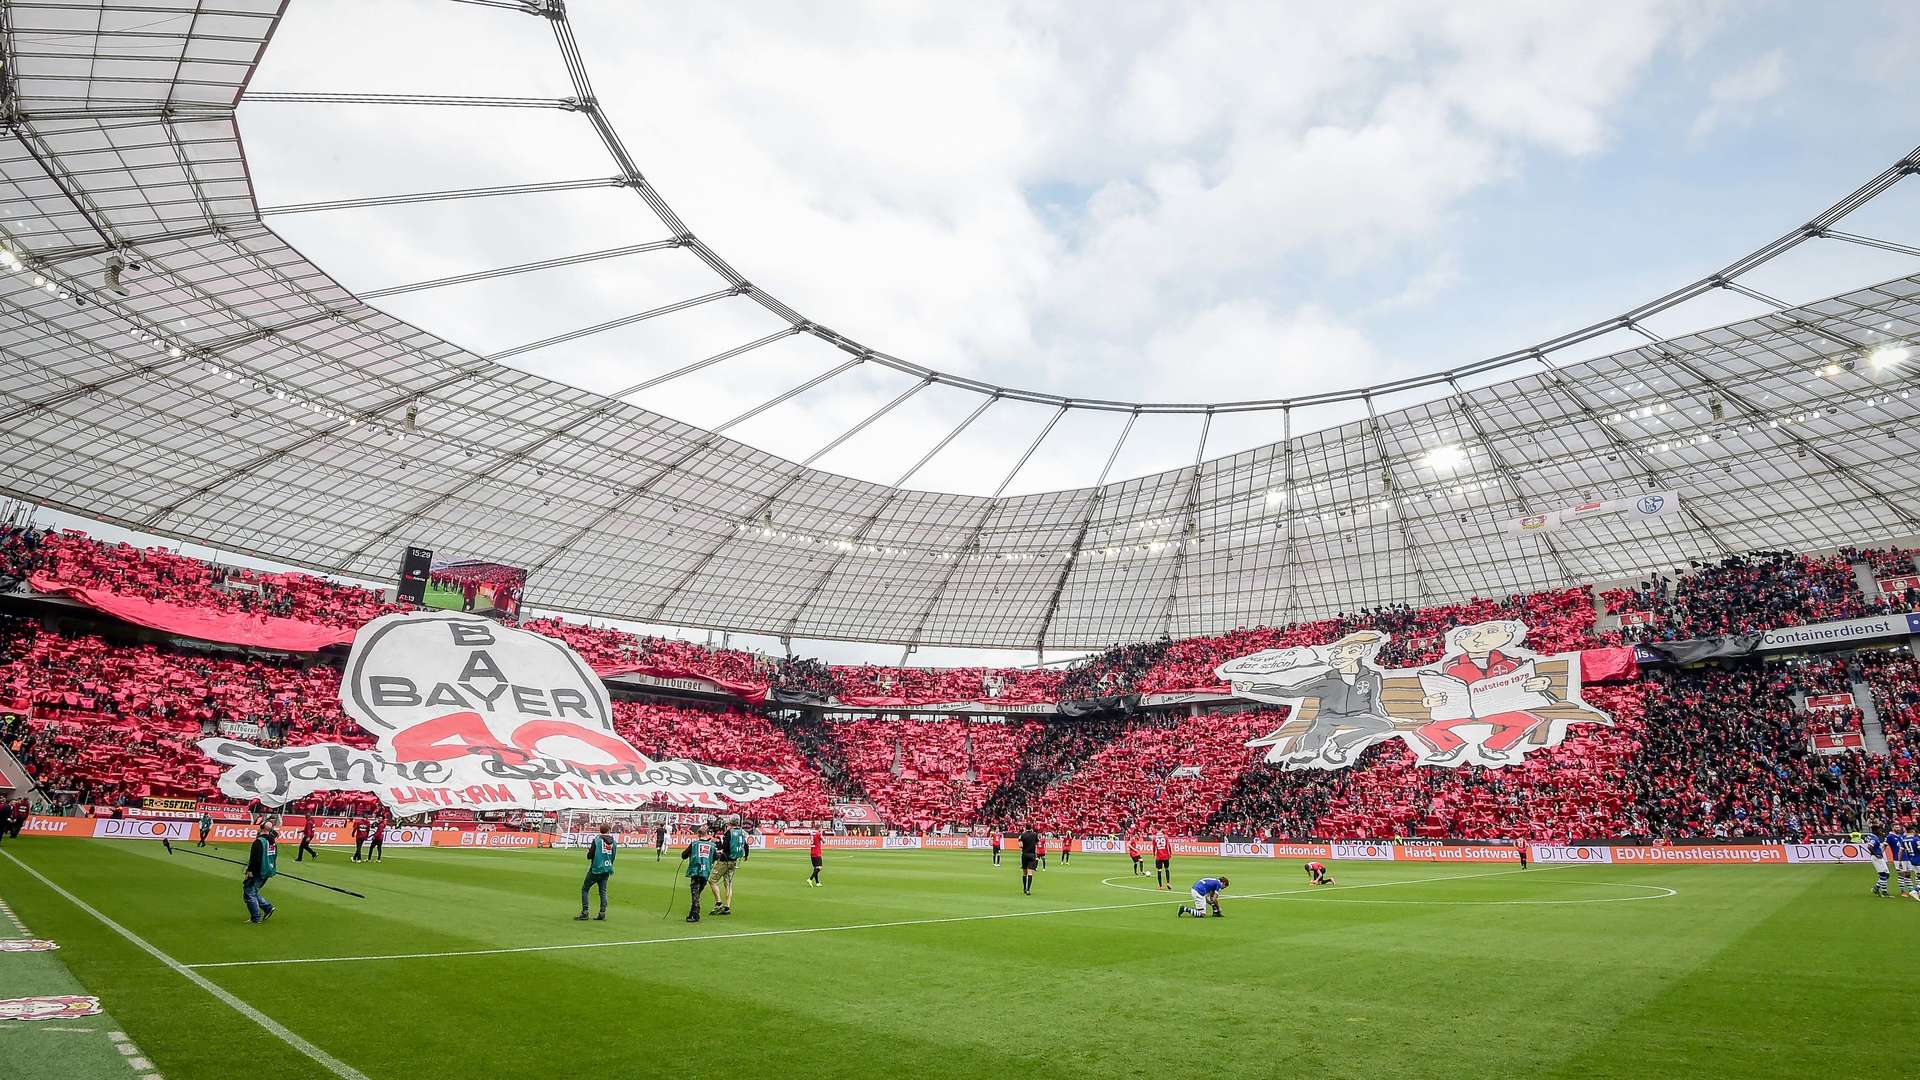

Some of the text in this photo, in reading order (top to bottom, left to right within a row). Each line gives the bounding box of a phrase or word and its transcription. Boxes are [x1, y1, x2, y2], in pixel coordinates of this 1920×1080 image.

[1764, 620, 1892, 646] Containerdienst
[1472, 680, 1510, 694] Aufstieg
[369, 675, 594, 719] BAYER
[217, 742, 452, 796] Jahre
[105, 820, 183, 836] DITCON
[490, 834, 534, 846] @ditcon
[886, 836, 917, 847] DITCON
[925, 837, 965, 847] ditcon.de
[1086, 840, 1121, 851] DITCON
[1156, 837, 1167, 850] 29
[1174, 843, 1220, 856] Betreuung
[1225, 843, 1269, 855] DITCON
[1280, 845, 1326, 856] ditcon.de
[1337, 846, 1388, 858] DITCON
[1439, 850, 1464, 860] und
[1466, 848, 1521, 860] Software
[1540, 847, 1604, 861] DITCON
[1616, 848, 1780, 862] EDV-Dienstleistungen
[1796, 845, 1872, 859] DITCON
